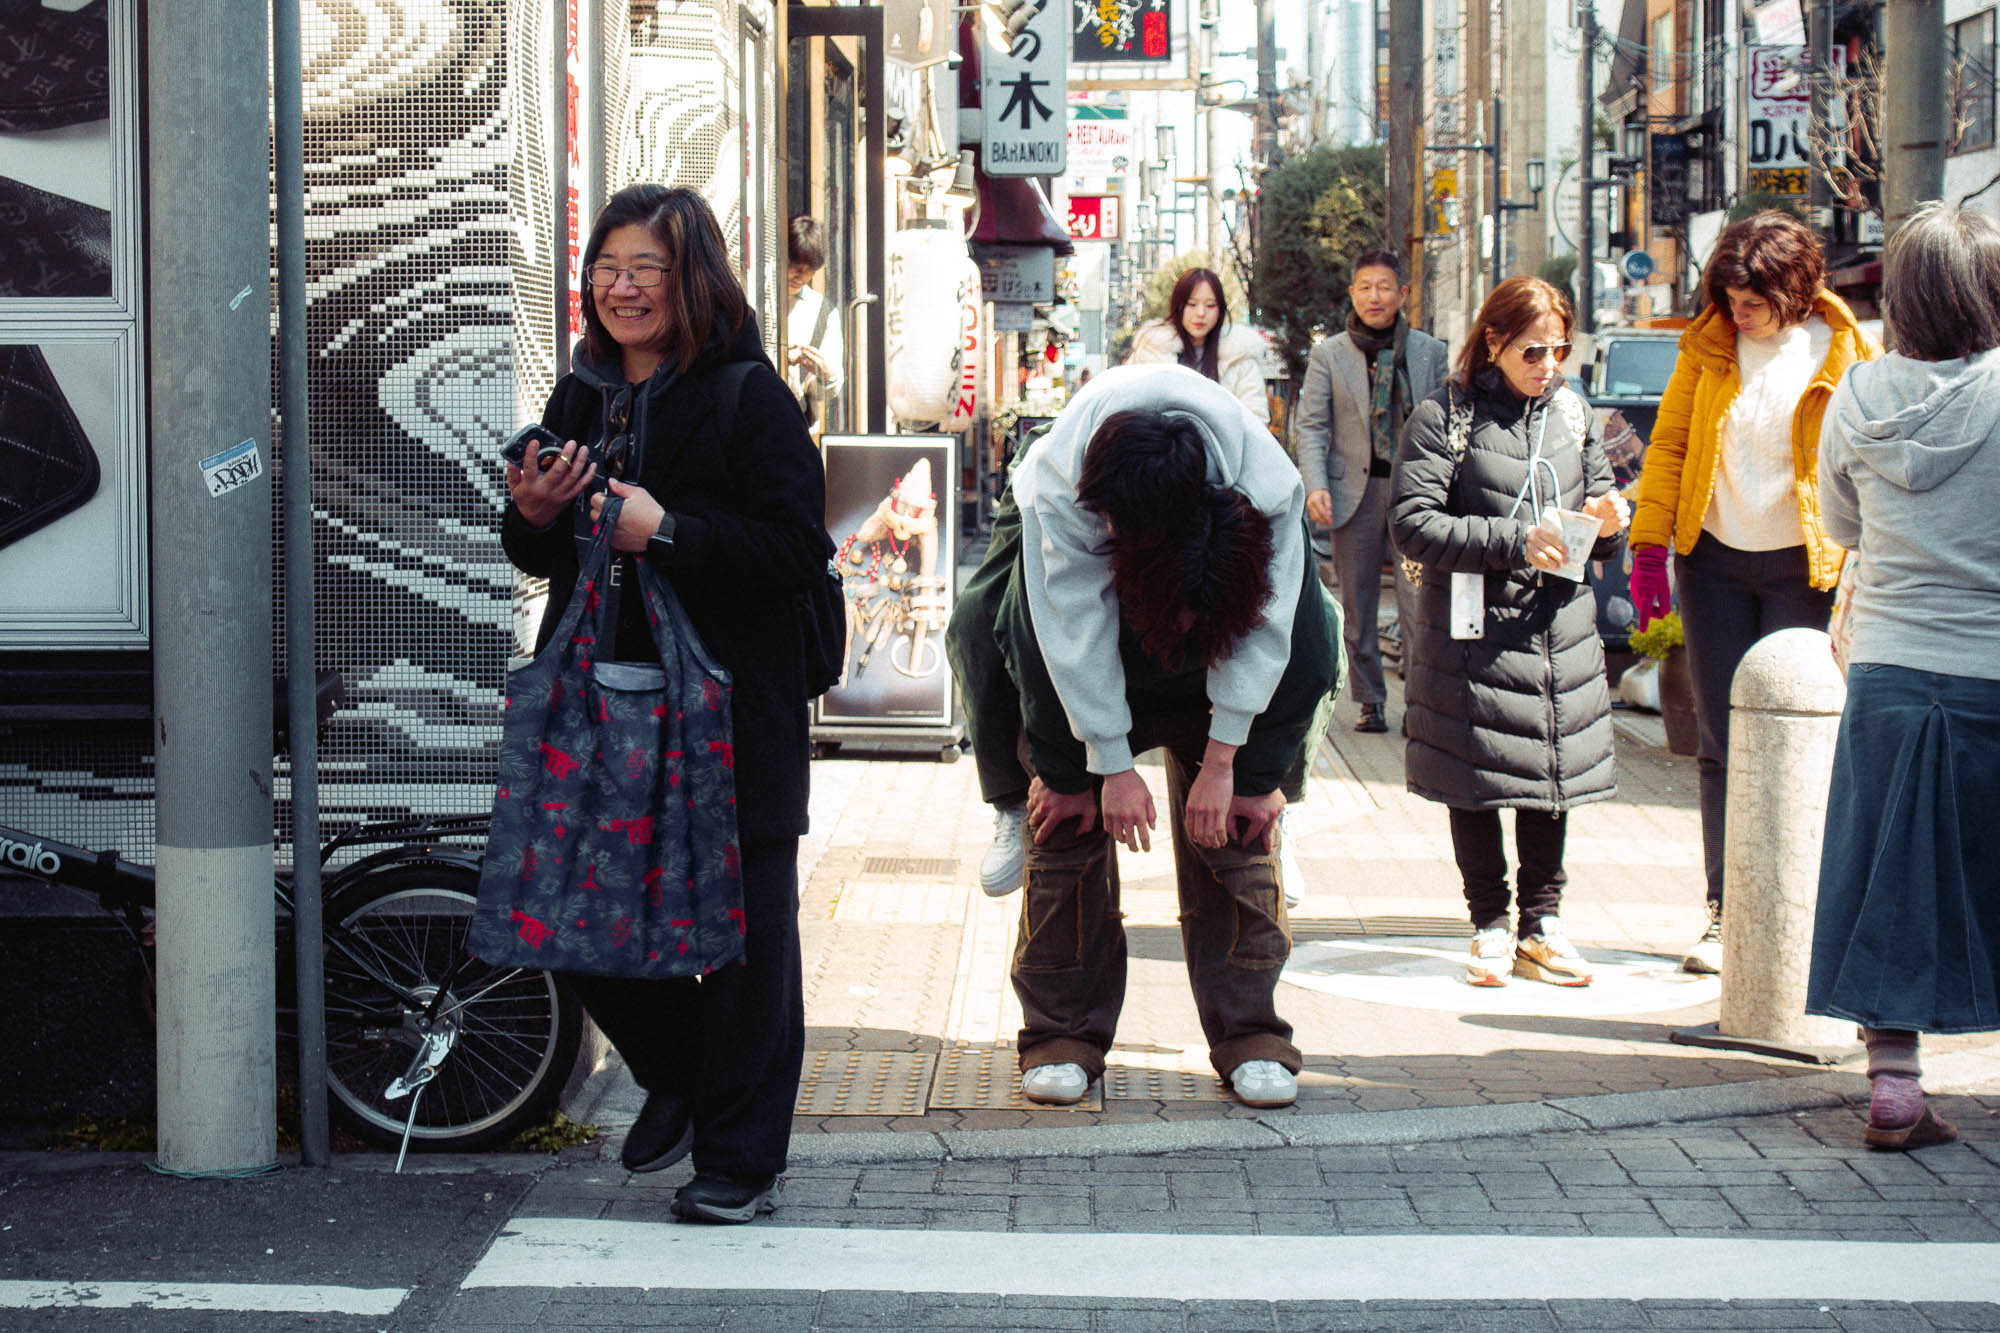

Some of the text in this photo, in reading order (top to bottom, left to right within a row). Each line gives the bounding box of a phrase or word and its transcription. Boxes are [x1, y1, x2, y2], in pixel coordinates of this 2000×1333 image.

[998, 0, 1054, 130] の木
[991, 141, 1060, 164] BARANOKI
[888, 252, 904, 363] ホルモン
[0, 836, 61, 875] rato
